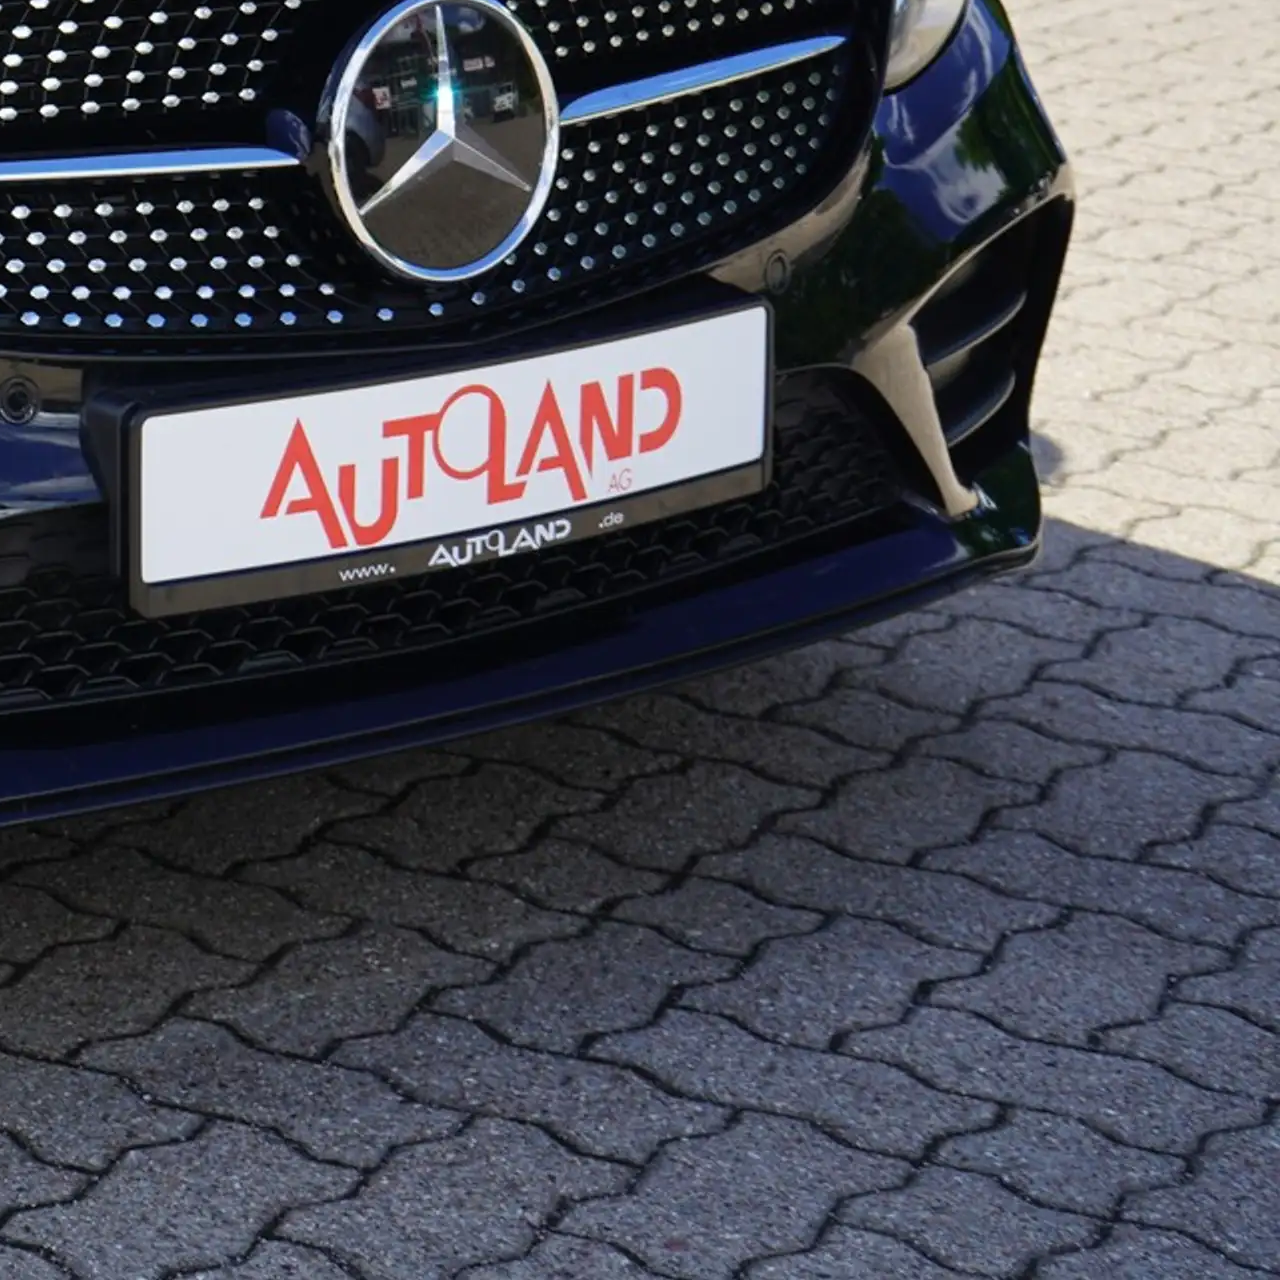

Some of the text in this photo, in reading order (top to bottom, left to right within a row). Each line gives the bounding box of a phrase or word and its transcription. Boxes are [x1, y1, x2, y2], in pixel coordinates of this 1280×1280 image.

[260, 367, 682, 549] AUTOLAND
[607, 468, 634, 493] AG
[339, 511, 625, 582] www. AUTOLAND .de
